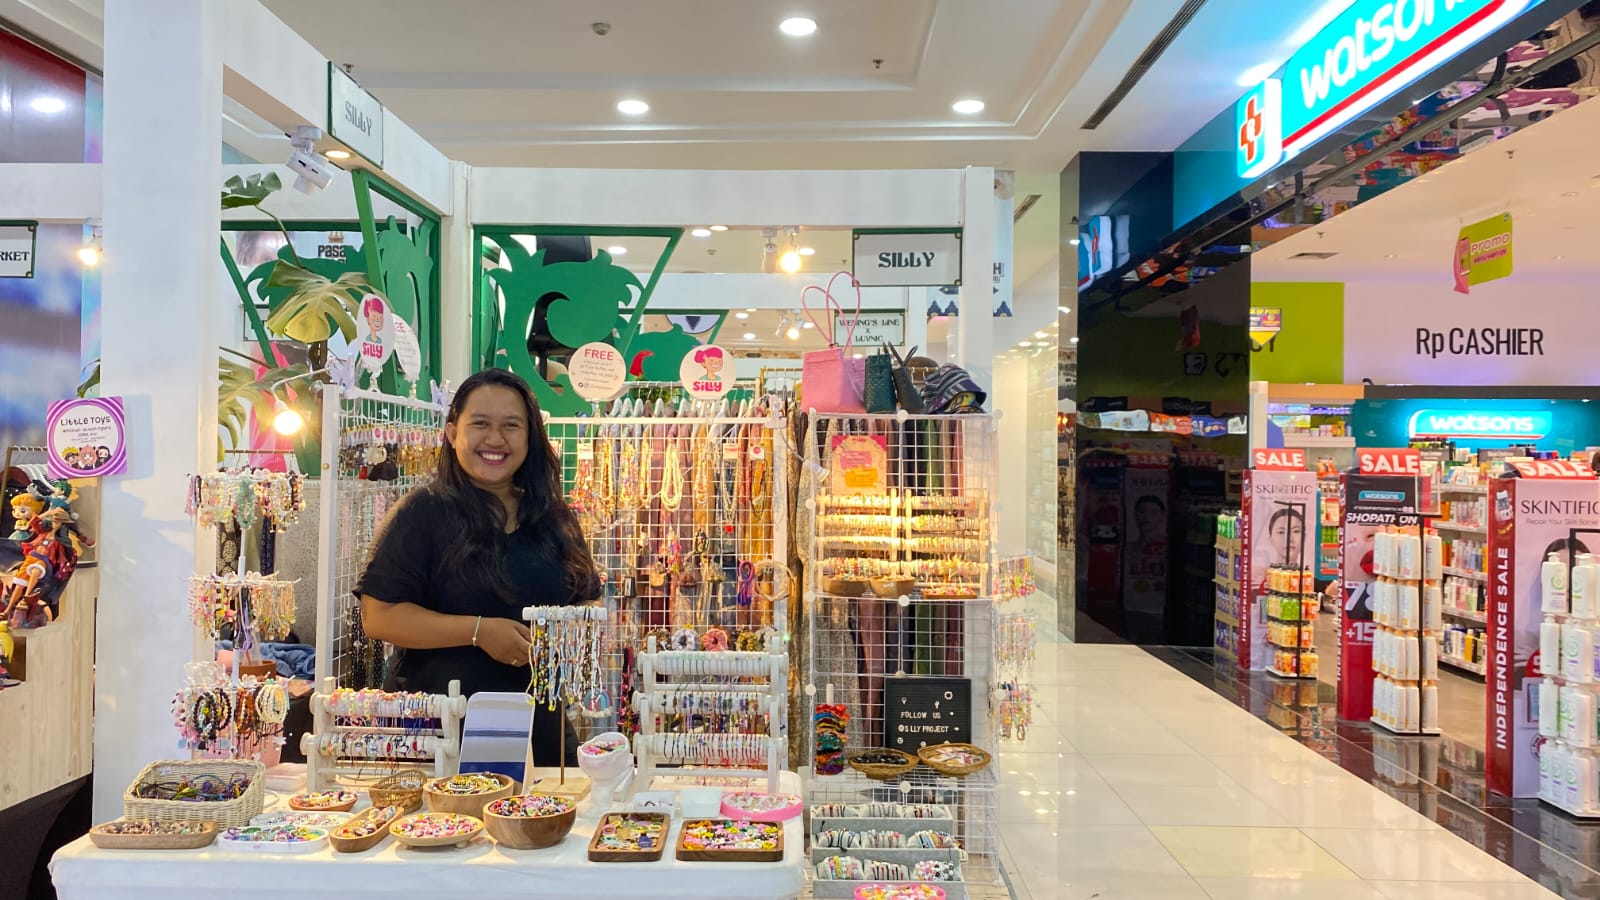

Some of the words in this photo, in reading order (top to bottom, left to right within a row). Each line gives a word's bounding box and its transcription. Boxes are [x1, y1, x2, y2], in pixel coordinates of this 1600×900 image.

[345, 101, 372, 136] SILLY
[878, 252, 935, 268] SILLY
[1416, 327, 1445, 359] Rp
[1448, 327, 1544, 356] CASHIER
[584, 348, 615, 361] FREE
[1430, 414, 1535, 432] watsons
[1255, 452, 1305, 468] SALE
[1360, 453, 1420, 473] SALE
[1515, 461, 1593, 477] SALE
[1255, 484, 1313, 495] SKINTIFIC
[1520, 500, 1600, 515] SKINTIFIC
[1497, 547, 1509, 597] SALE
[1496, 601, 1508, 750] INDEPENDENCE
[900, 711, 928, 719] FOLLOW
[932, 711, 941, 719] US
[922, 725, 949, 733] PROJECT
